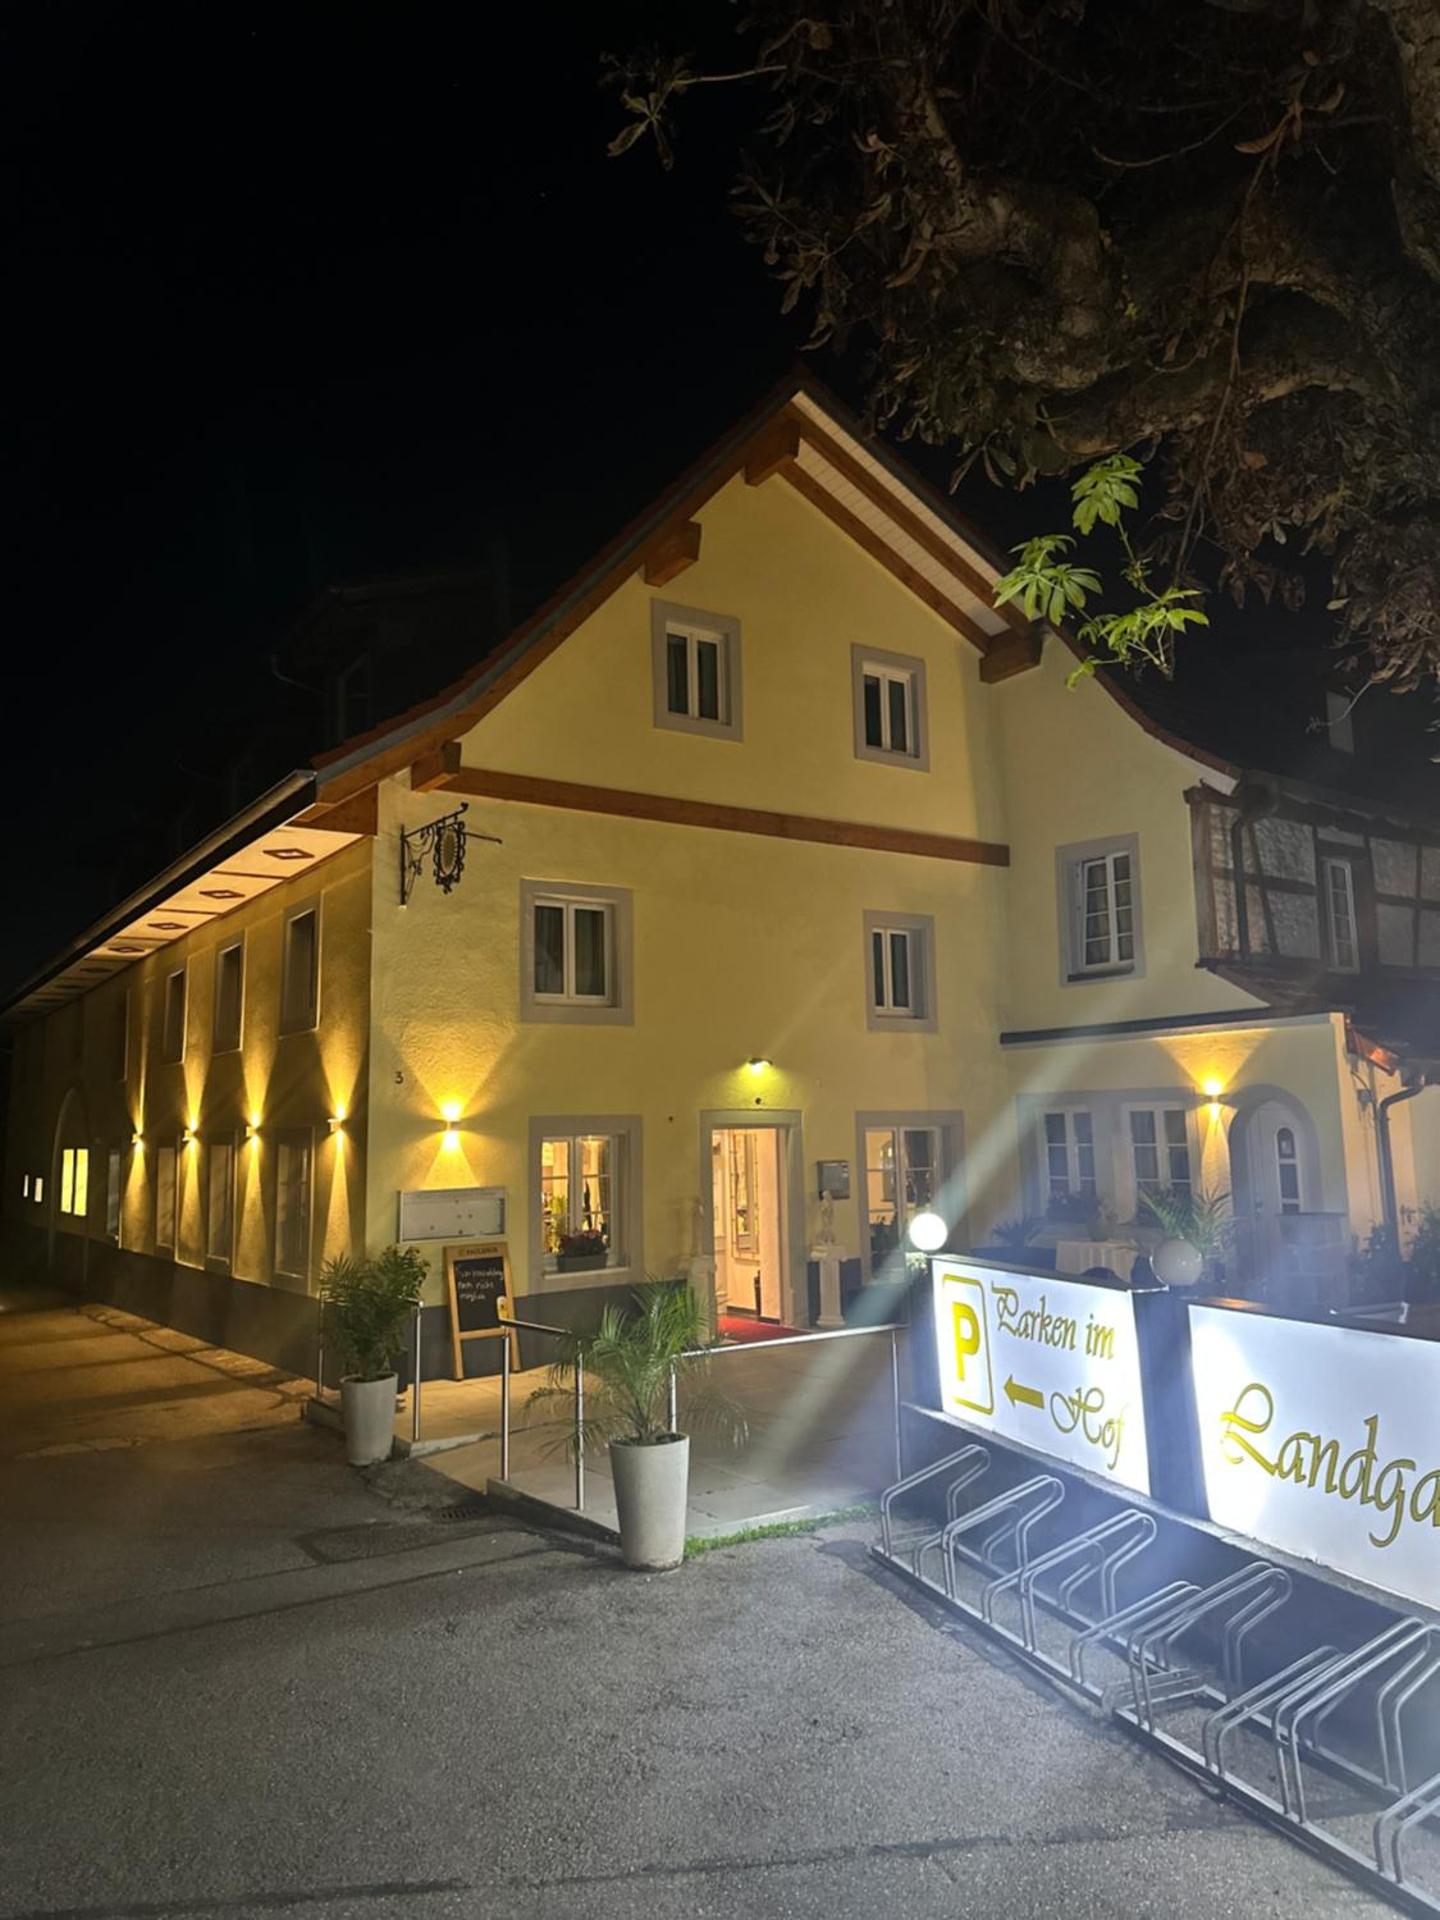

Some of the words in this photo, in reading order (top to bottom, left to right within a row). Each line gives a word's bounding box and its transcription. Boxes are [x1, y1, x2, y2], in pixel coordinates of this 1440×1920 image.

[395, 1070, 404, 1085] 3
[952, 1301, 980, 1381] P
[991, 1281, 1077, 1351] Parken
[1085, 1313, 1115, 1360] im
[1050, 1387, 1126, 1470] Hof
